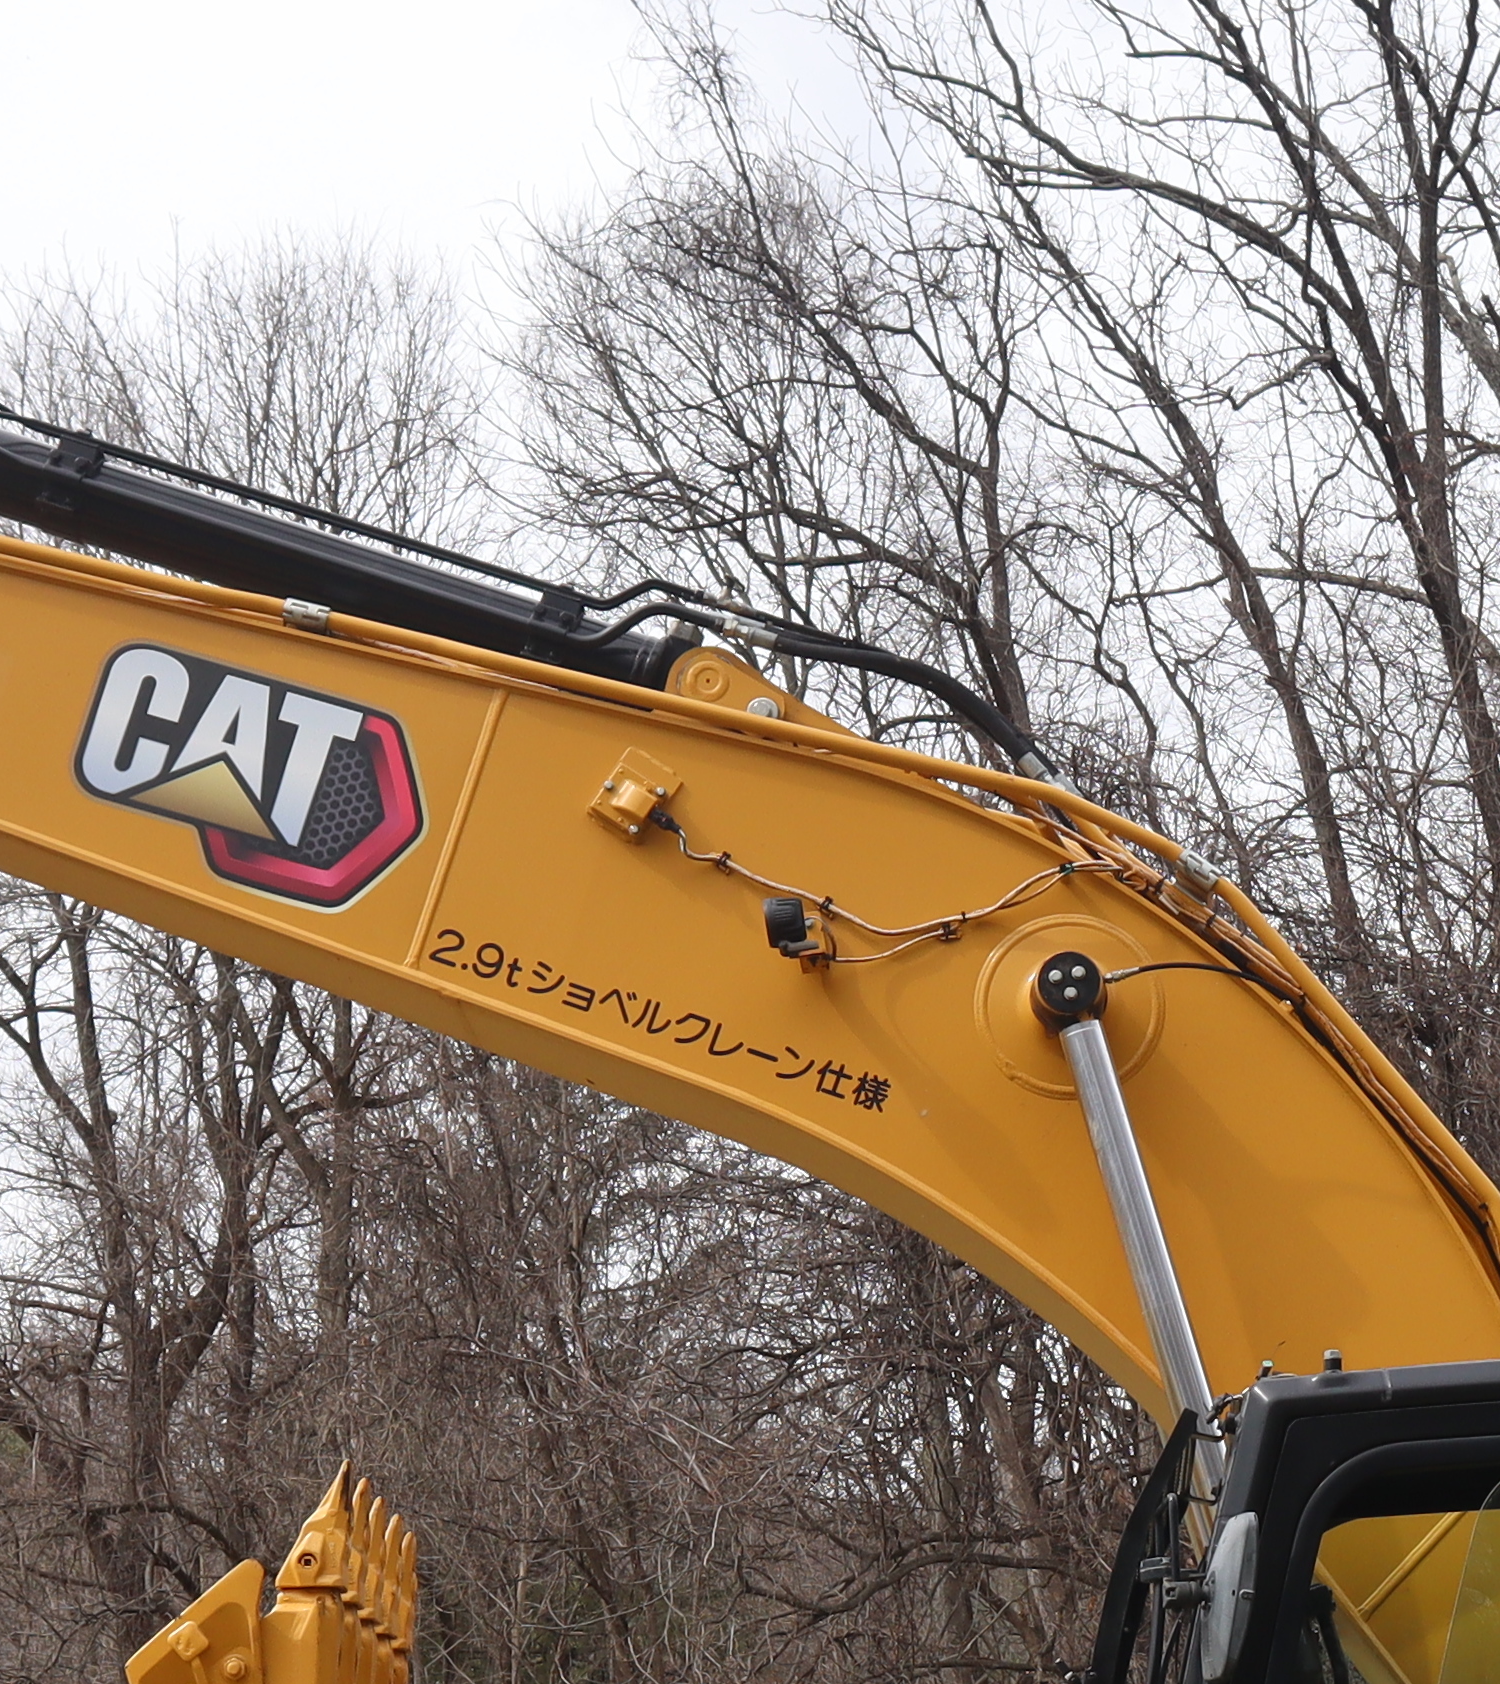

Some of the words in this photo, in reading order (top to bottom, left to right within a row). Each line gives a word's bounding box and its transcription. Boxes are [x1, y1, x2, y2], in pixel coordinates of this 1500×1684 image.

[82, 648, 363, 847] CAT
[429, 929, 891, 1112] 2.9tショベルクレーン仕様
